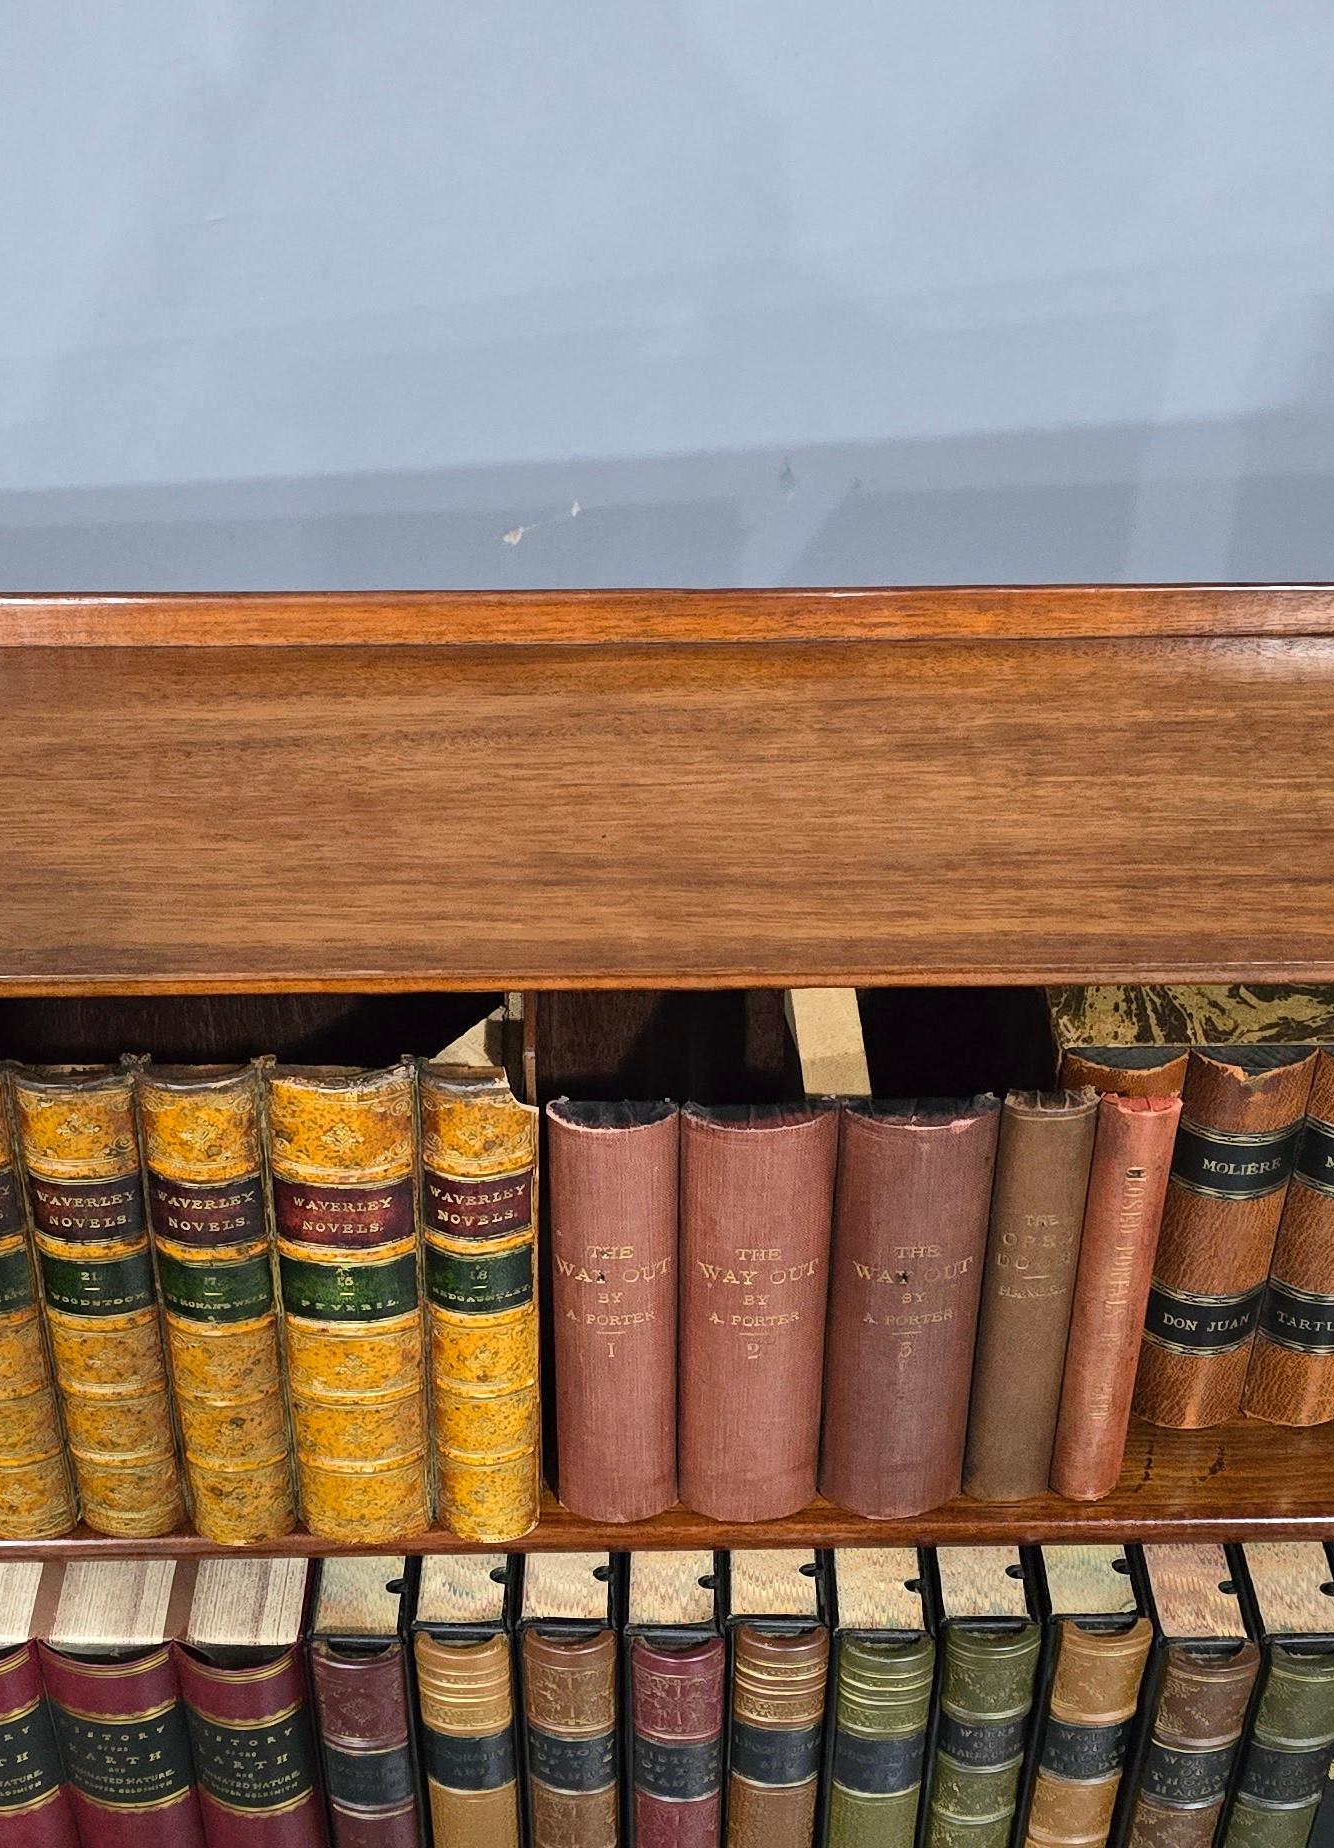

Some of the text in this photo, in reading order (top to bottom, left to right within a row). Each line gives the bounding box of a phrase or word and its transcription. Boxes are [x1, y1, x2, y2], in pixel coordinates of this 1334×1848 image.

[36, 1190, 136, 1208] WAVERLEY
[157, 1190, 256, 1210] WAVERLEY
[429, 1184, 526, 1206] WAVERLEY
[293, 1196, 394, 1213] WAVERLEY
[49, 1215, 132, 1229] NOVELS.
[168, 1216, 251, 1232] NOVELS.
[436, 1209, 519, 1226] NOVELS.
[302, 1221, 384, 1234] NOVELS.
[587, 1246, 634, 1259] THE
[735, 1248, 782, 1261] THE
[893, 1244, 941, 1259] THE
[555, 1254, 672, 1284] WAY OUT
[697, 1257, 819, 1285] WAY OUT
[852, 1255, 974, 1285] WAY OUT
[597, 1292, 624, 1303] BY
[743, 1294, 770, 1306] BY
[901, 1292, 927, 1304] BY
[586, 1311, 656, 1326] PORTER
[730, 1311, 800, 1327] PORTER
[885, 1308, 954, 1326] PORTER
[1163, 1313, 1250, 1332] DON JUAN
[747, 1343, 760, 1359] 2
[74, 1725, 165, 1741] ISTORY
[203, 1727, 293, 1746] ISTORY
[125, 1768, 175, 1785] NATURE
[252, 1769, 300, 1790] NATURE
